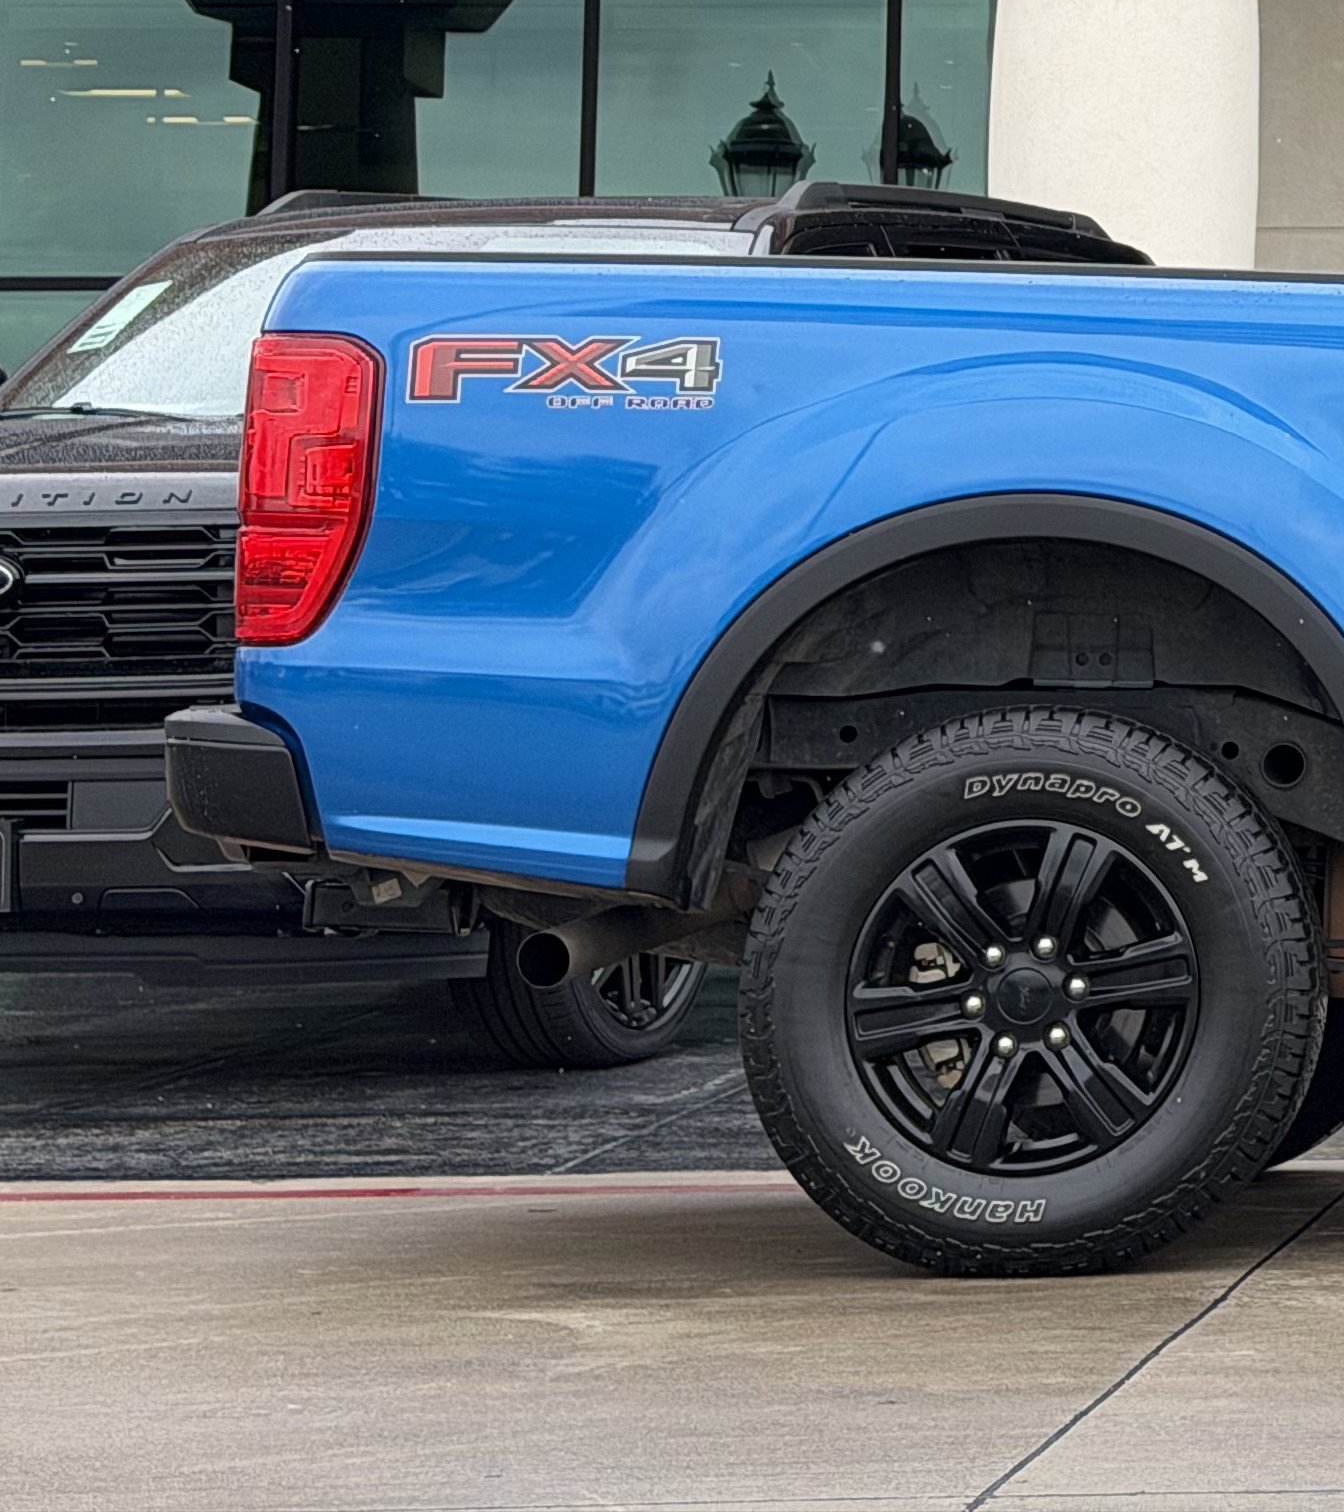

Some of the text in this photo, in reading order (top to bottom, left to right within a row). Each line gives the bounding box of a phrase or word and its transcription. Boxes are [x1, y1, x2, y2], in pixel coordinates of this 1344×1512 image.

[405, 334, 723, 404] FX4
[546, 395, 715, 410] OFF ROAD
[963, 773, 1142, 818] Dynapro
